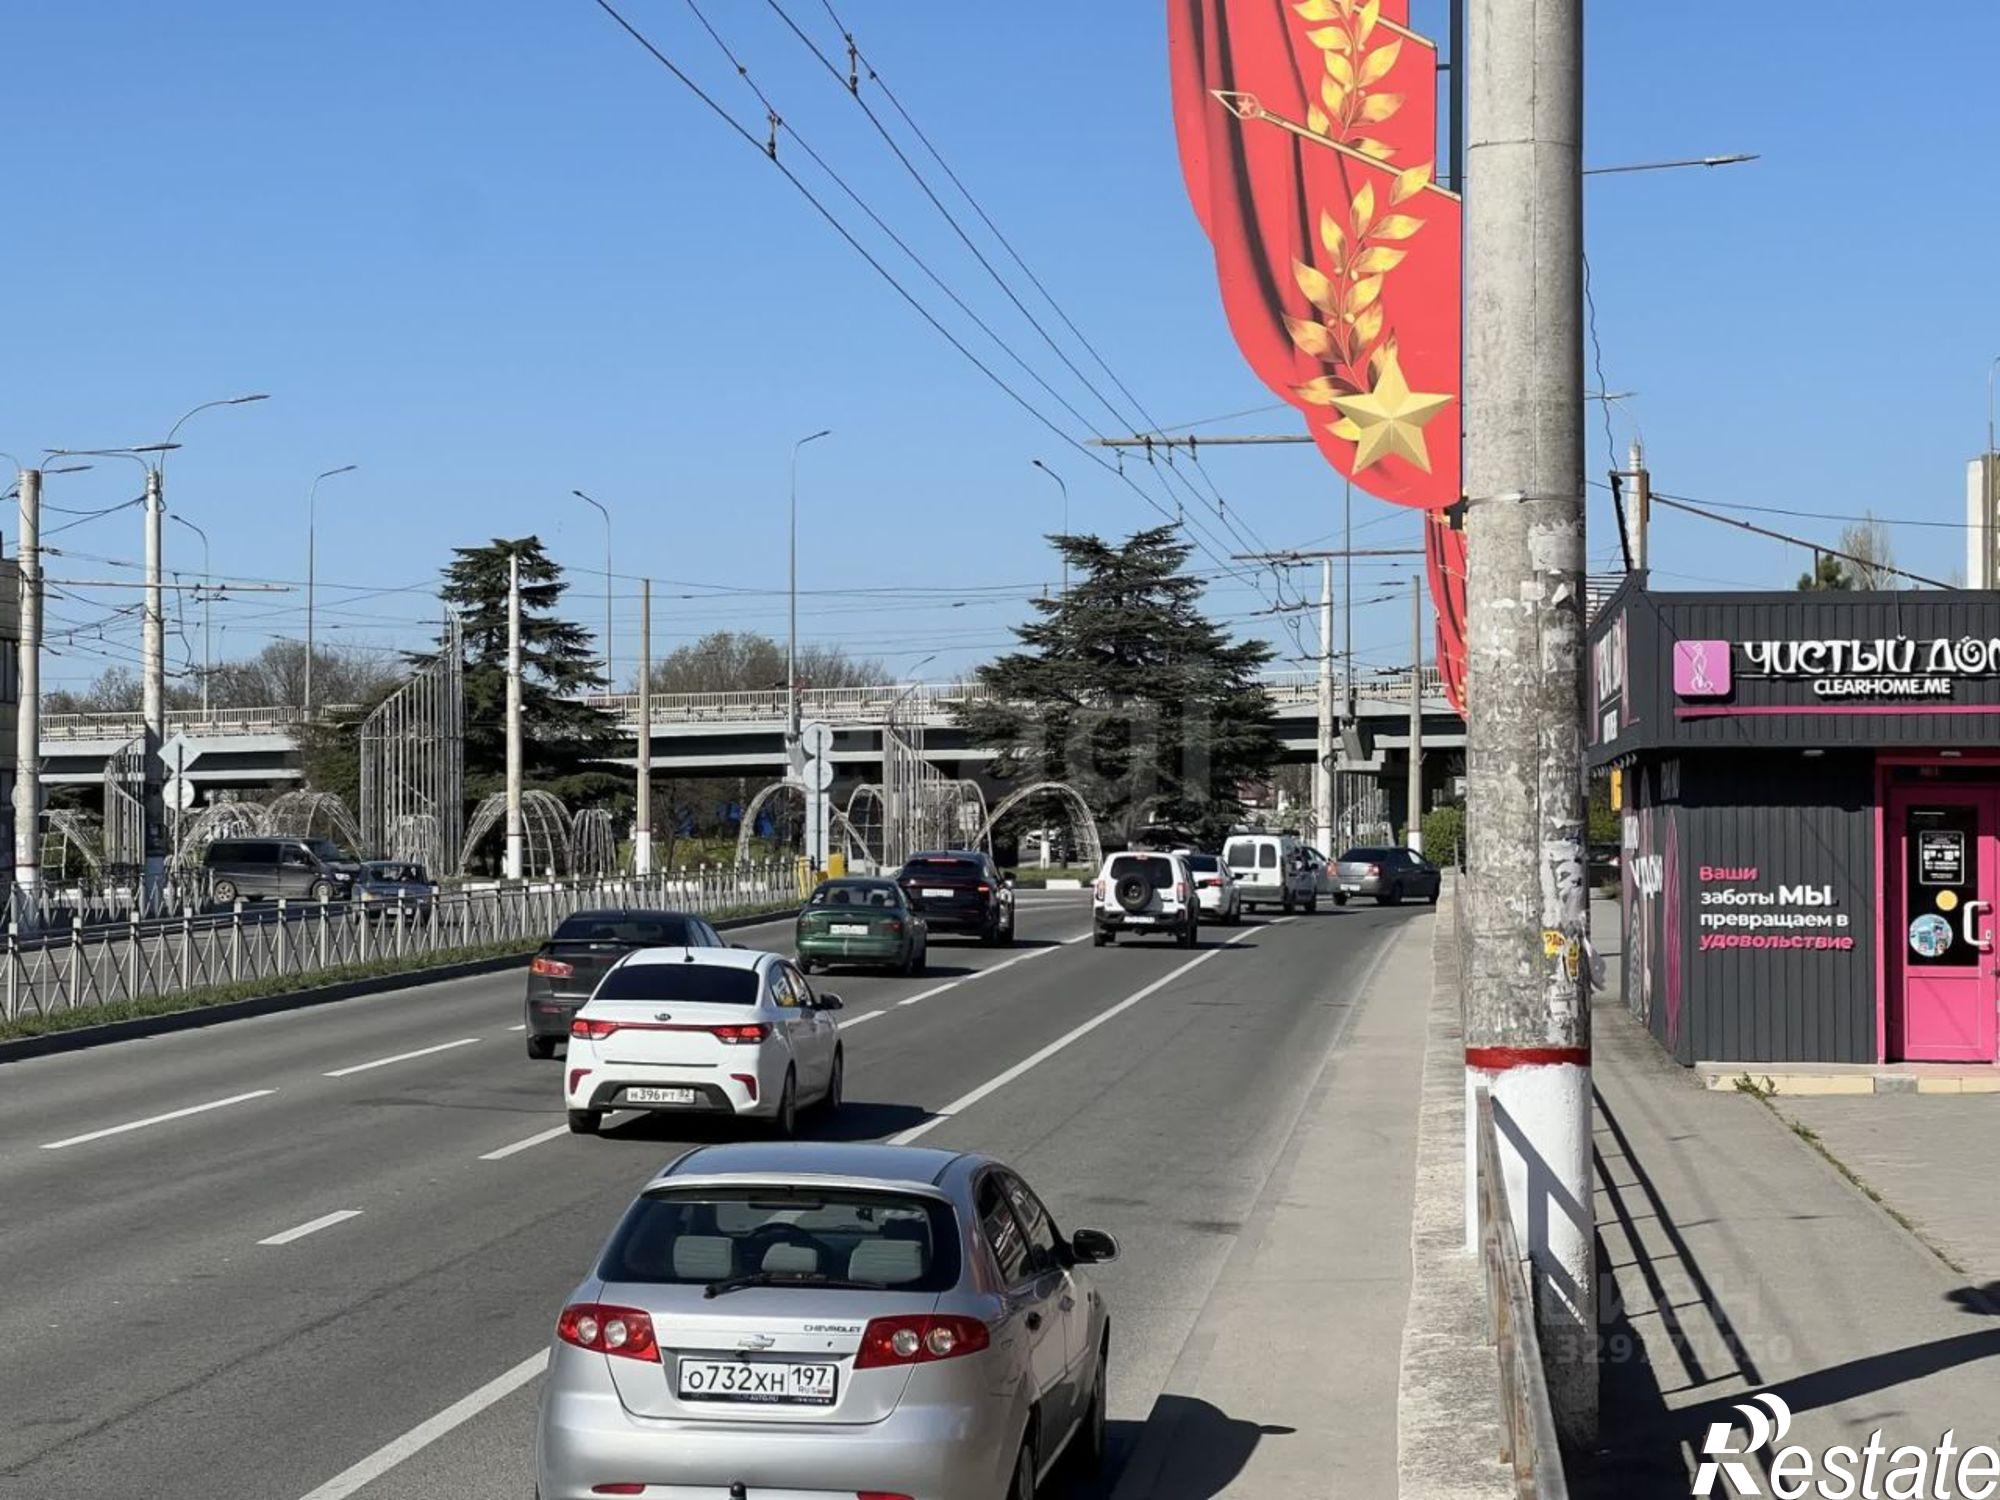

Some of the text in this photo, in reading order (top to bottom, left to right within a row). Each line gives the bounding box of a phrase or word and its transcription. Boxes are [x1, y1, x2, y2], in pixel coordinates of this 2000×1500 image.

[1813, 678, 1951, 695] CLEARHOME.ME
[1699, 866, 1758, 881] Ваши
[1700, 888, 1775, 905] заботы
[1700, 913, 1849, 930] превращаем в
[1700, 933, 1854, 950] удовольствие
[792, 1366, 828, 1386] 197
